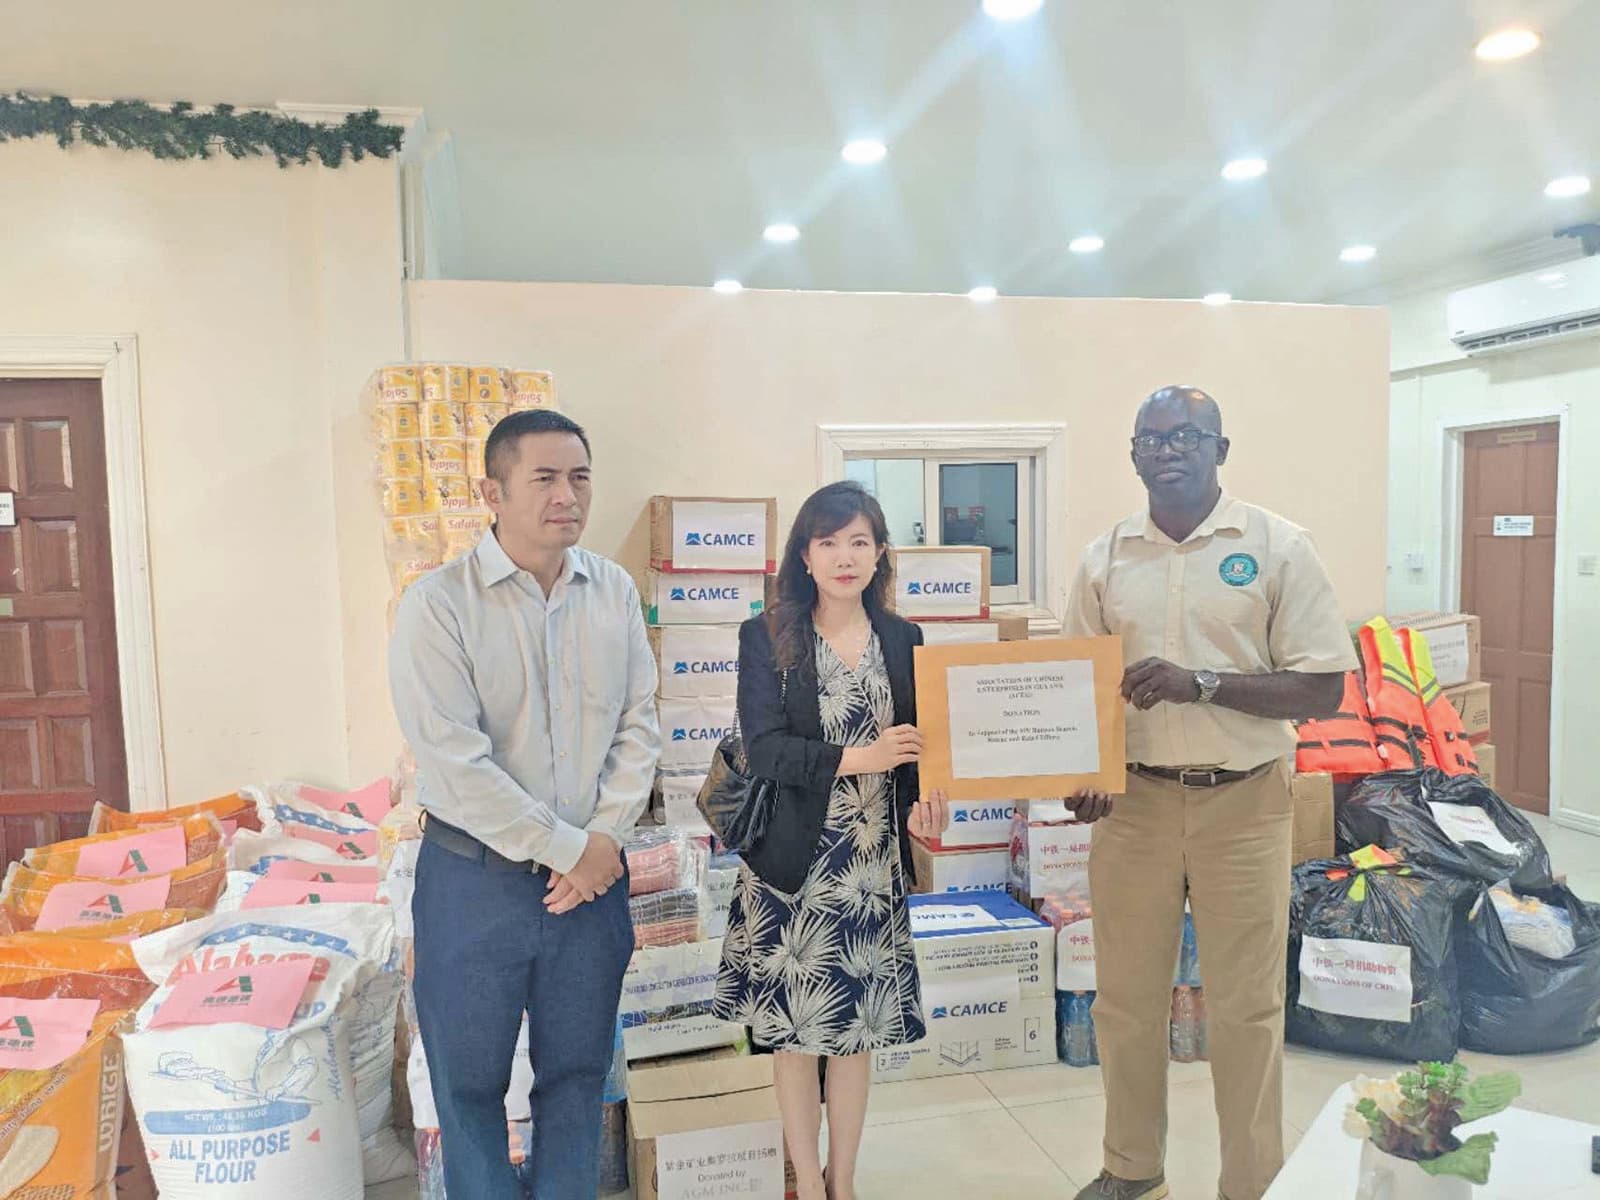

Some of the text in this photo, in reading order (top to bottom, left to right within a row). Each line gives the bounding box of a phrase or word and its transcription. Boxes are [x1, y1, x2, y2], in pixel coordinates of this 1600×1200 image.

[703, 533, 756, 546] CAMCE
[687, 587, 740, 601] CAMCE
[923, 582, 972, 594] CAMCE
[976, 677, 1022, 686] ASSOCIATION
[976, 684, 1025, 694] ENTERPRISES
[1033, 682, 1064, 690] GUYANA
[950, 1001, 1008, 1017] CAMCE
[1029, 1029, 1037, 1040] 6
[168, 1129, 291, 1161] ALL PURPOSE
[194, 1159, 257, 1184] FLOUR
[697, 1169, 747, 1183] Donated by
